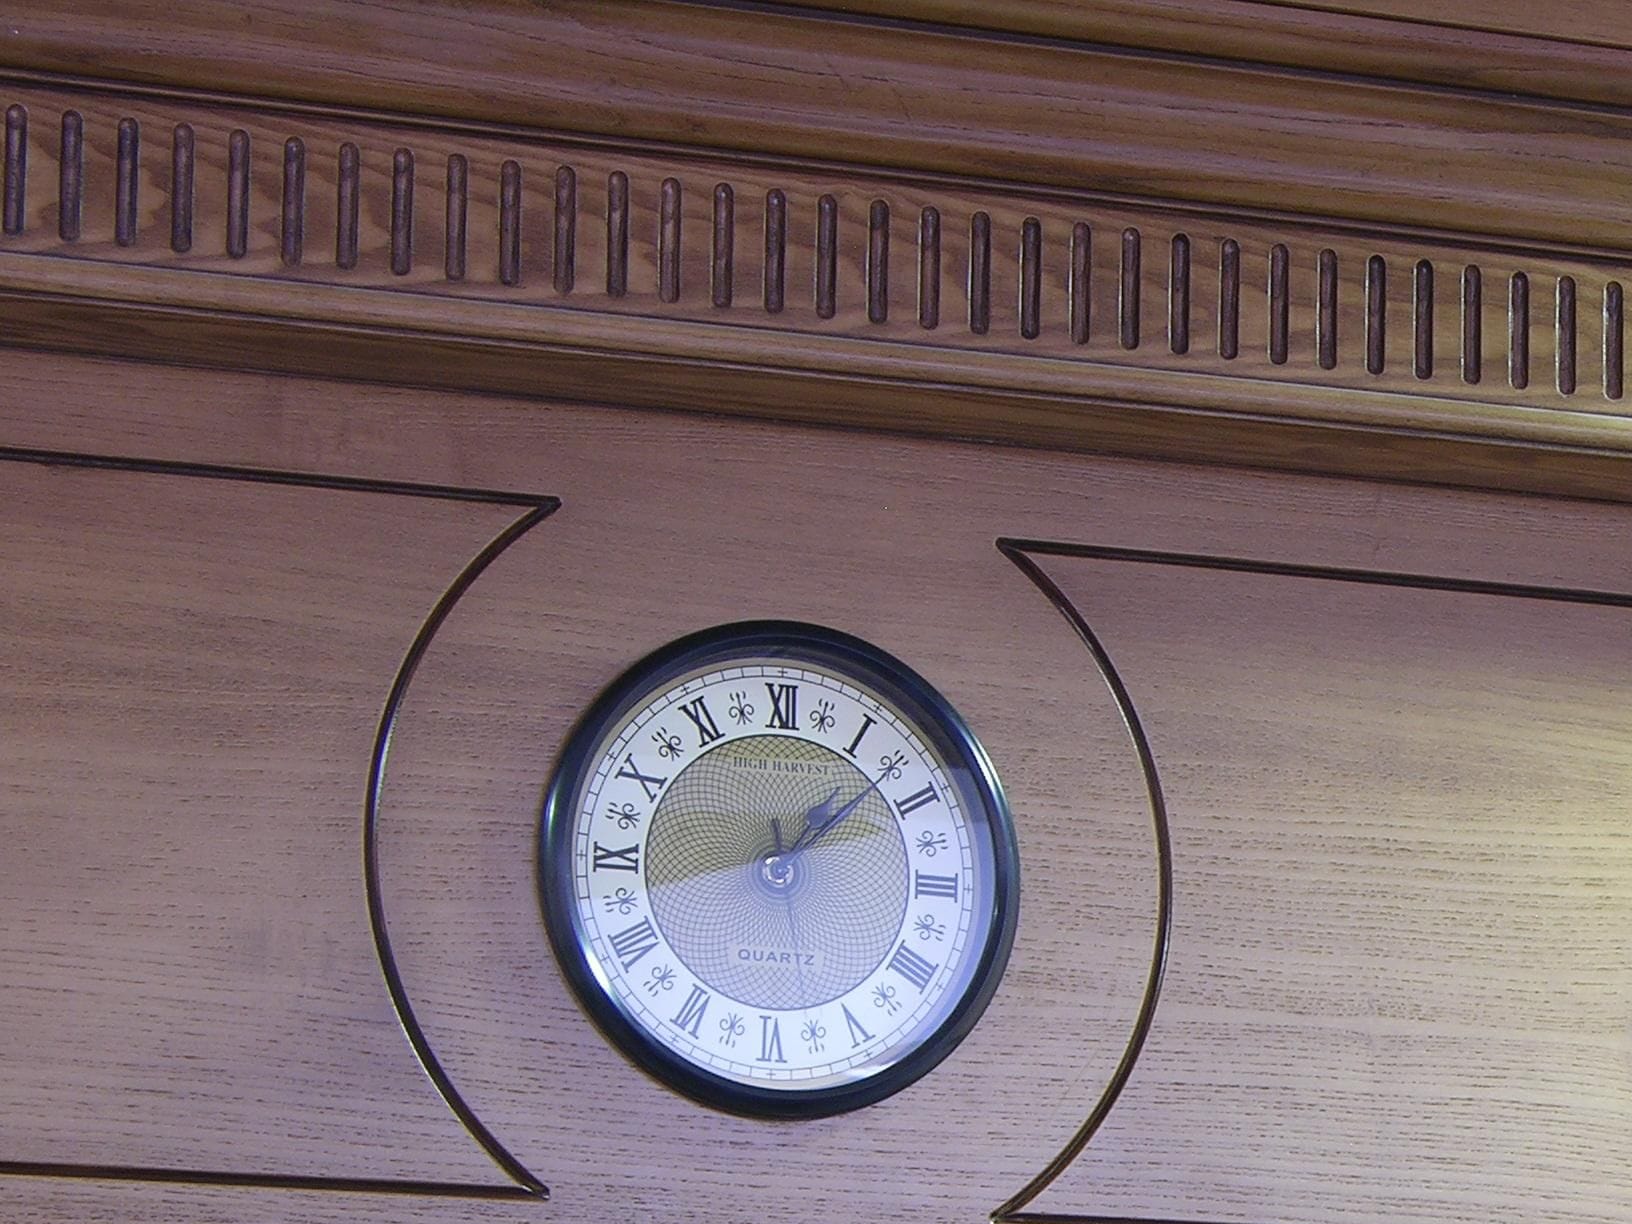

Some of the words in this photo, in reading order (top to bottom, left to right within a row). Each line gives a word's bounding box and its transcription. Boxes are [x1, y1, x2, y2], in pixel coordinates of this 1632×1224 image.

[683, 696, 725, 748] XI
[766, 683, 799, 730] XII
[843, 713, 876, 758] I
[617, 754, 668, 803] X
[733, 756, 768, 771] HIGH
[772, 760, 831, 776] HARVEST
[894, 781, 941, 820] II
[593, 842, 639, 874] IX
[915, 870, 959, 903] III
[608, 916, 658, 974] VIII
[738, 949, 814, 966] QUARTZ
[886, 940, 939, 995] IIII
[671, 984, 705, 1039] VII
[841, 1003, 876, 1048] V
[756, 1016, 787, 1063] VI
